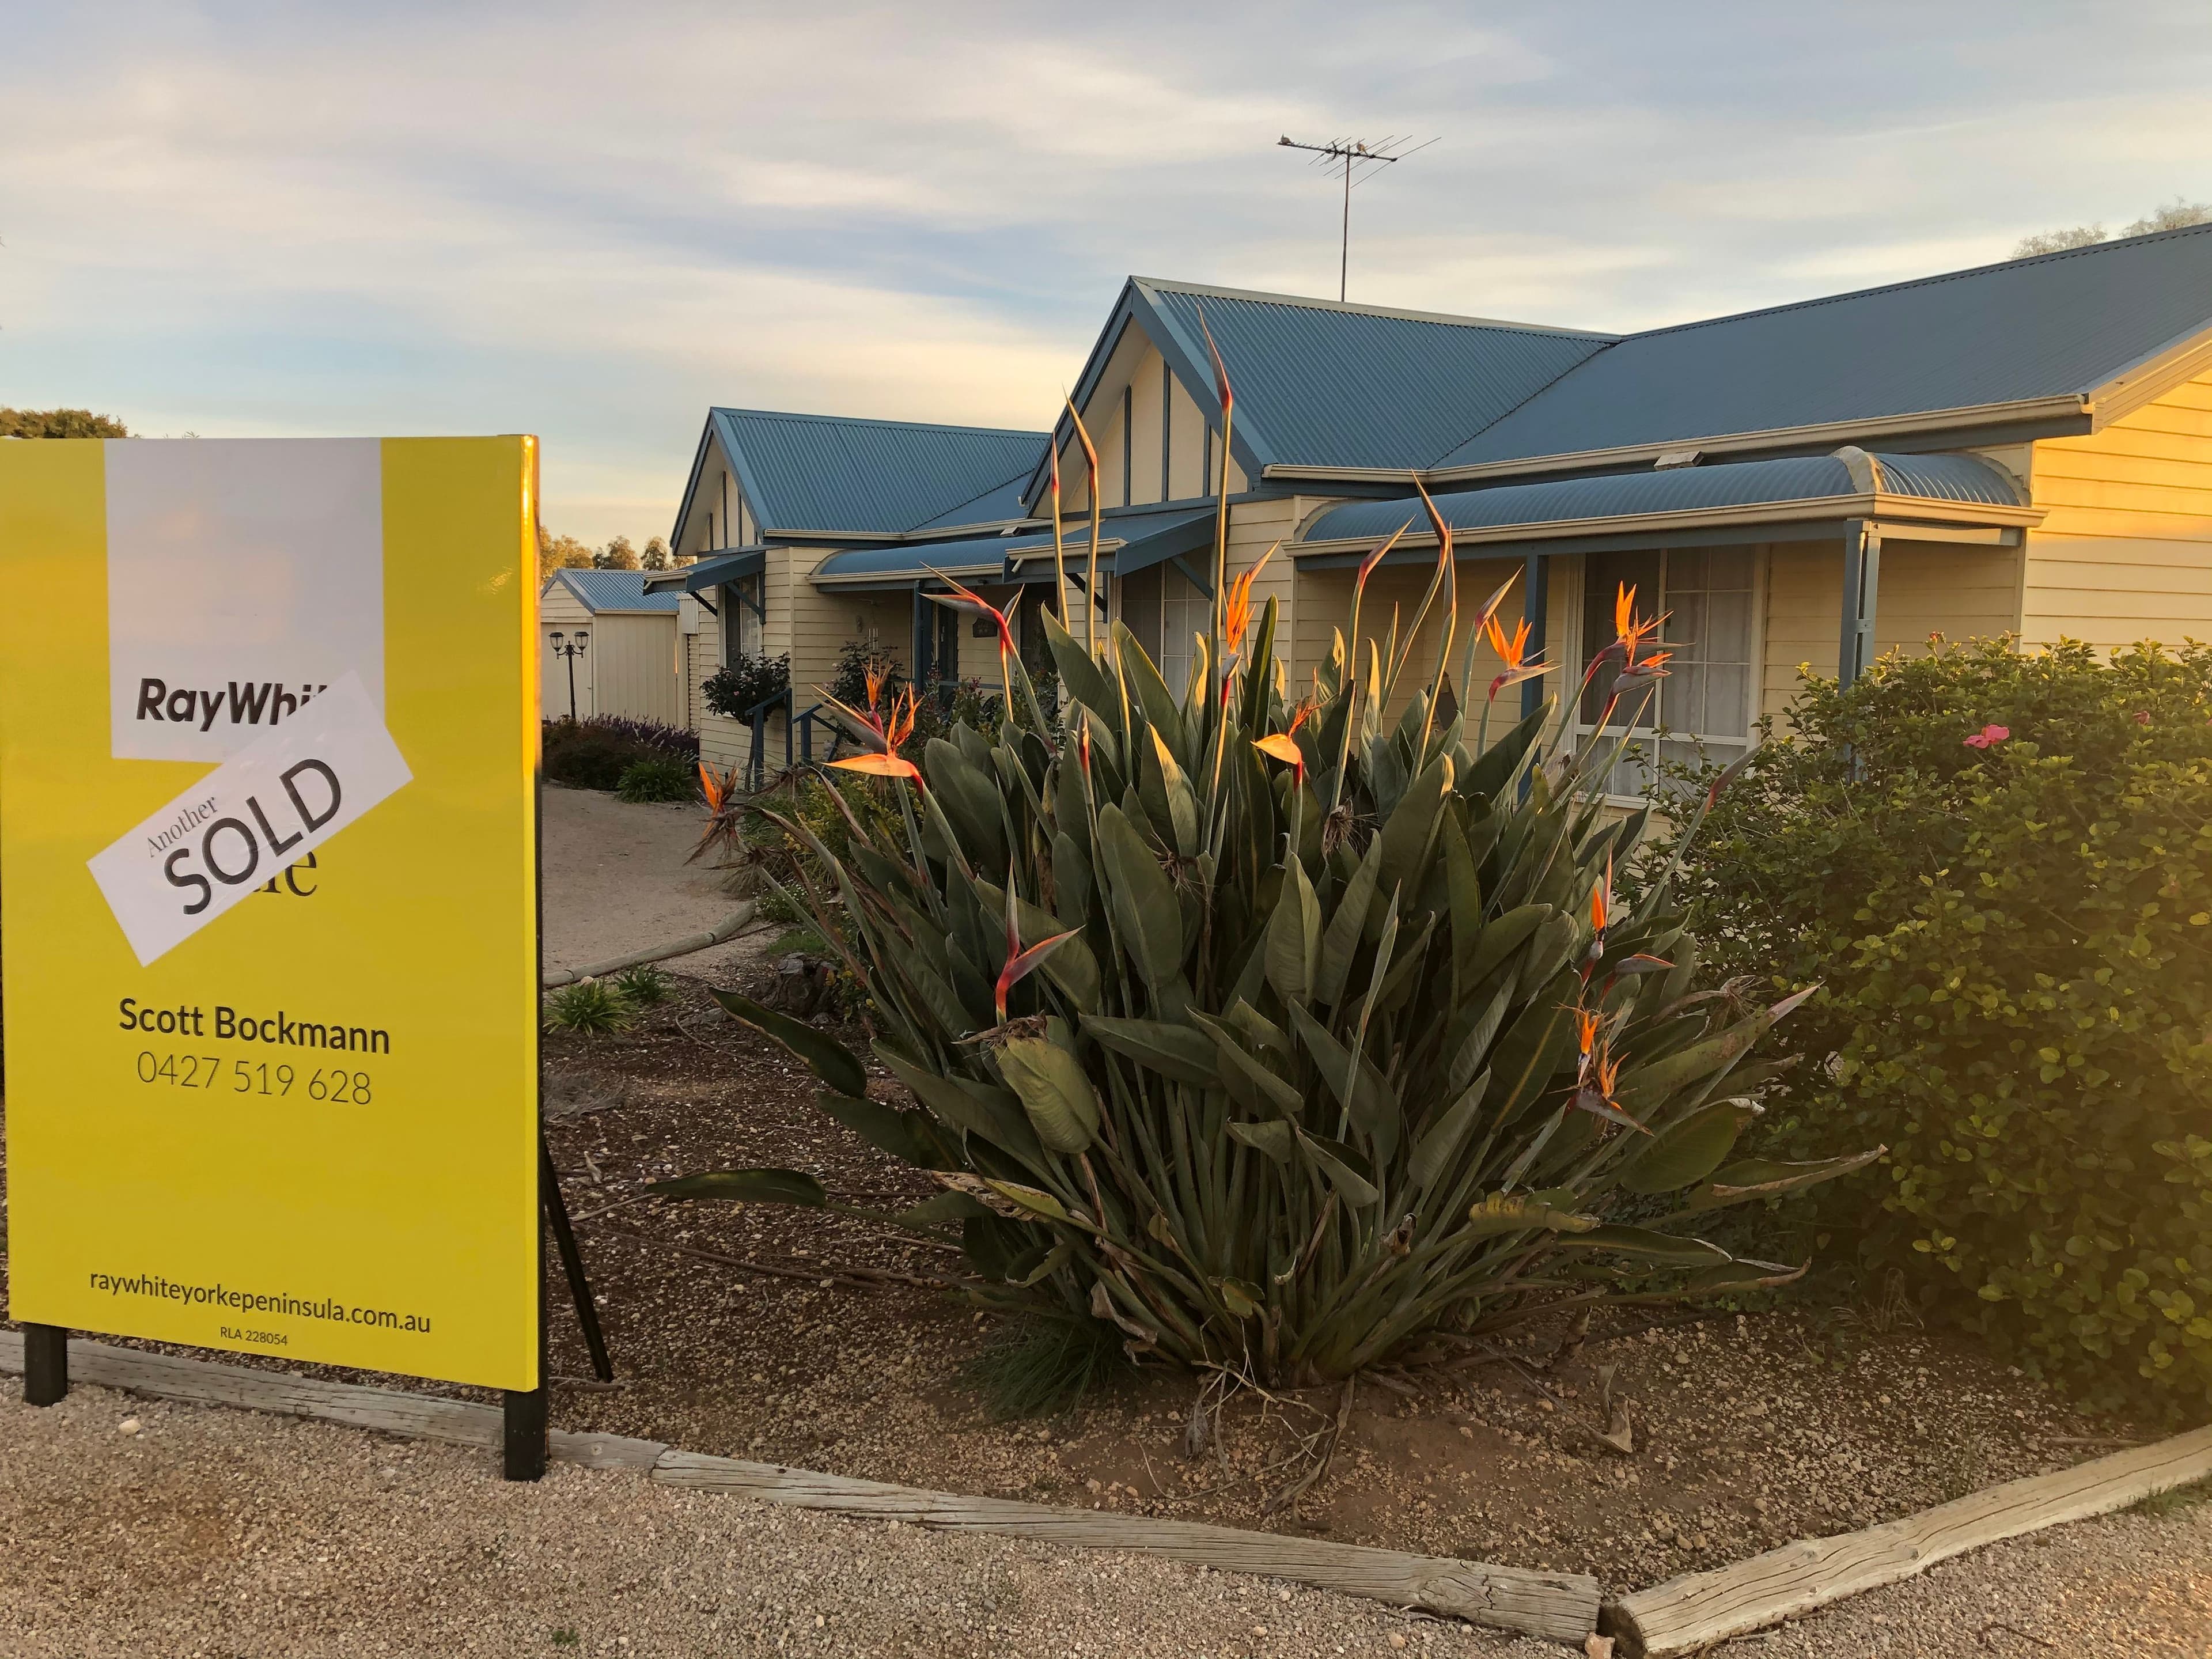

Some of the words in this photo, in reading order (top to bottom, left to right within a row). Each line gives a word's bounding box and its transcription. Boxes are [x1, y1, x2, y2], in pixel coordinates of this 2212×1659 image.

[136, 678, 327, 732] RayWh
[147, 797, 217, 858] Another
[164, 759, 341, 915] SOLD
[119, 998, 203, 1036] Scott
[215, 1006, 389, 1054] Bockmann
[137, 1051, 219, 1089] 0427
[233, 1060, 294, 1097] 519
[309, 1068, 372, 1105] 628
[90, 1272, 430, 1334] raywhiteyorkepeninsula.com.au
[220, 1327, 242, 1340] RLA
[245, 1330, 287, 1346] 228054
